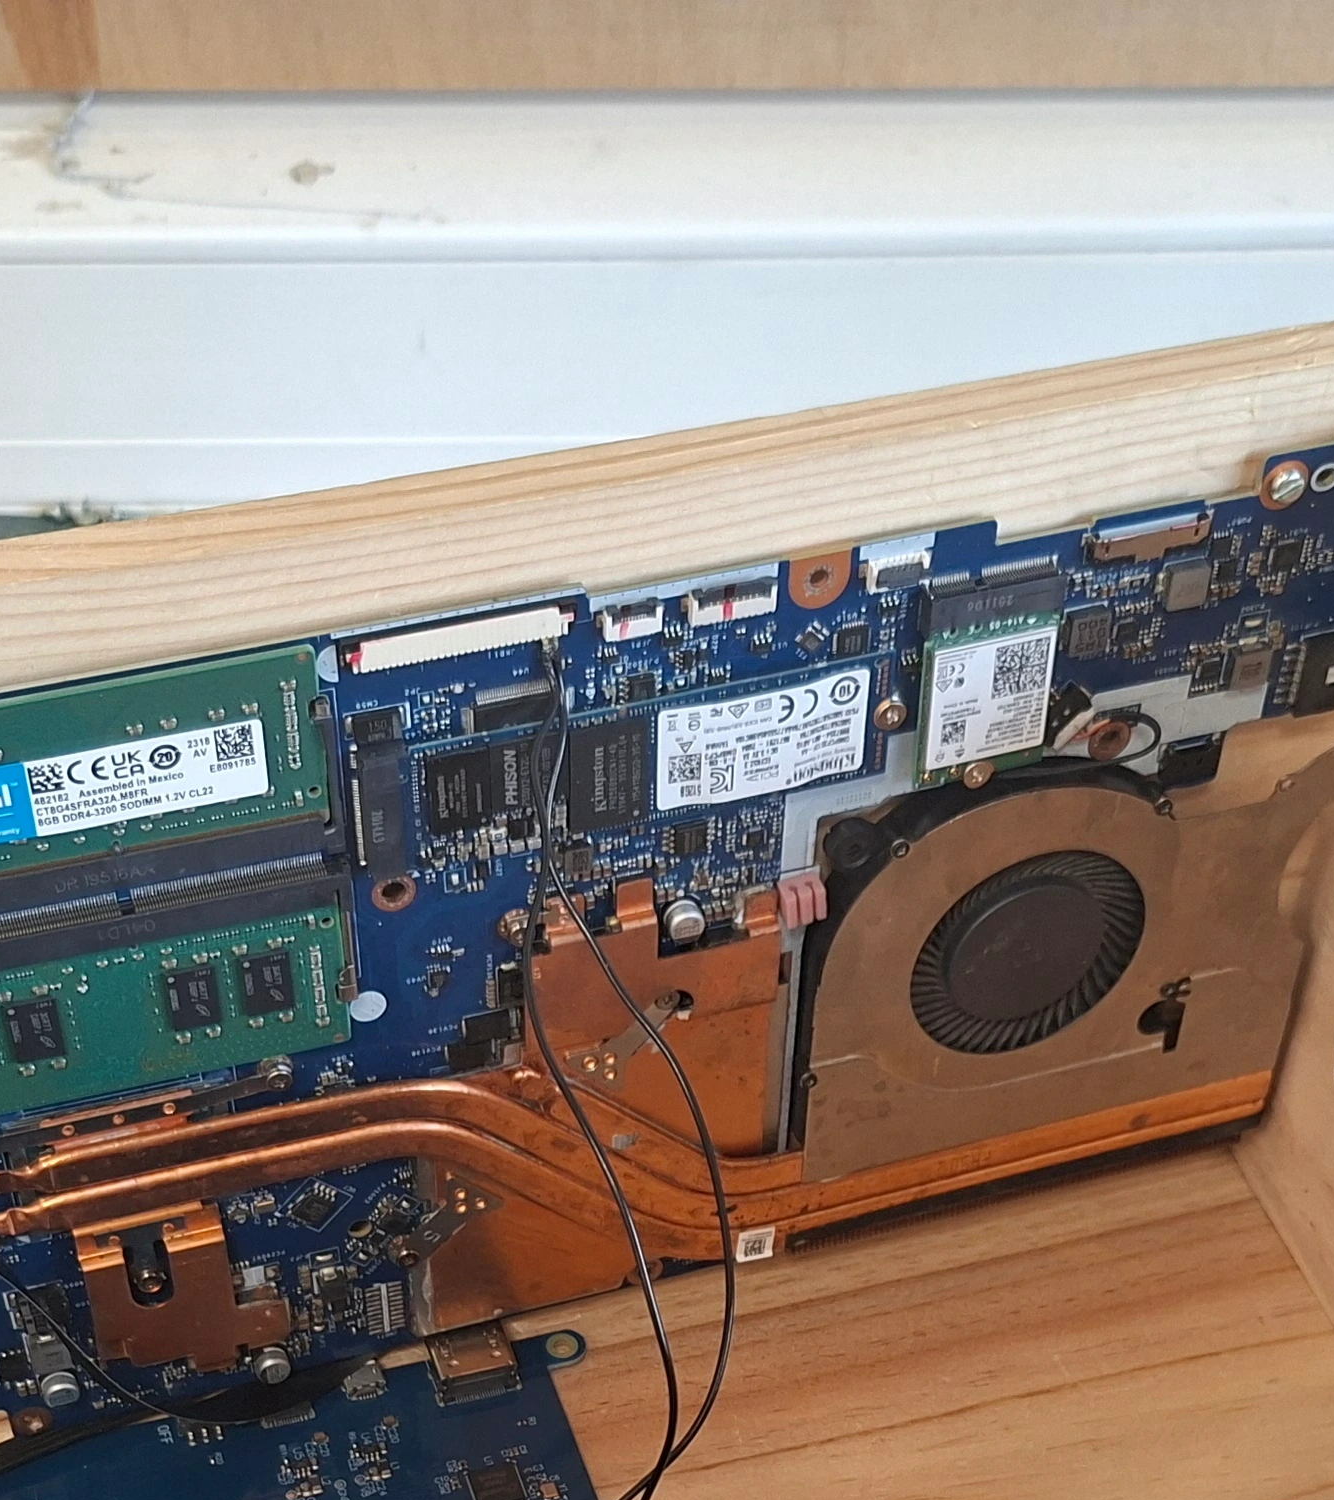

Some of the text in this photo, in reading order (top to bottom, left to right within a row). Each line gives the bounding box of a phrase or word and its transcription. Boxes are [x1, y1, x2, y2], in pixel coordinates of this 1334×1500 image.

[776, 686, 819, 724] CE
[186, 737, 211, 750] 2318
[193, 747, 209, 759] AV
[67, 755, 110, 785] CE
[496, 747, 526, 807] PHISON
[584, 744, 616, 814] Kingston
[792, 752, 855, 782] Kingston
[78, 779, 135, 799] Assembled
[148, 771, 185, 786] Mexico
[679, 783, 701, 798] 512GB
[35, 788, 149, 818] CT8G4SFRA32A.M8FR
[37, 785, 215, 828] 8GB DDR4-3200 SODIMM 1.2V CL22
[157, 1426, 175, 1445] OFF
